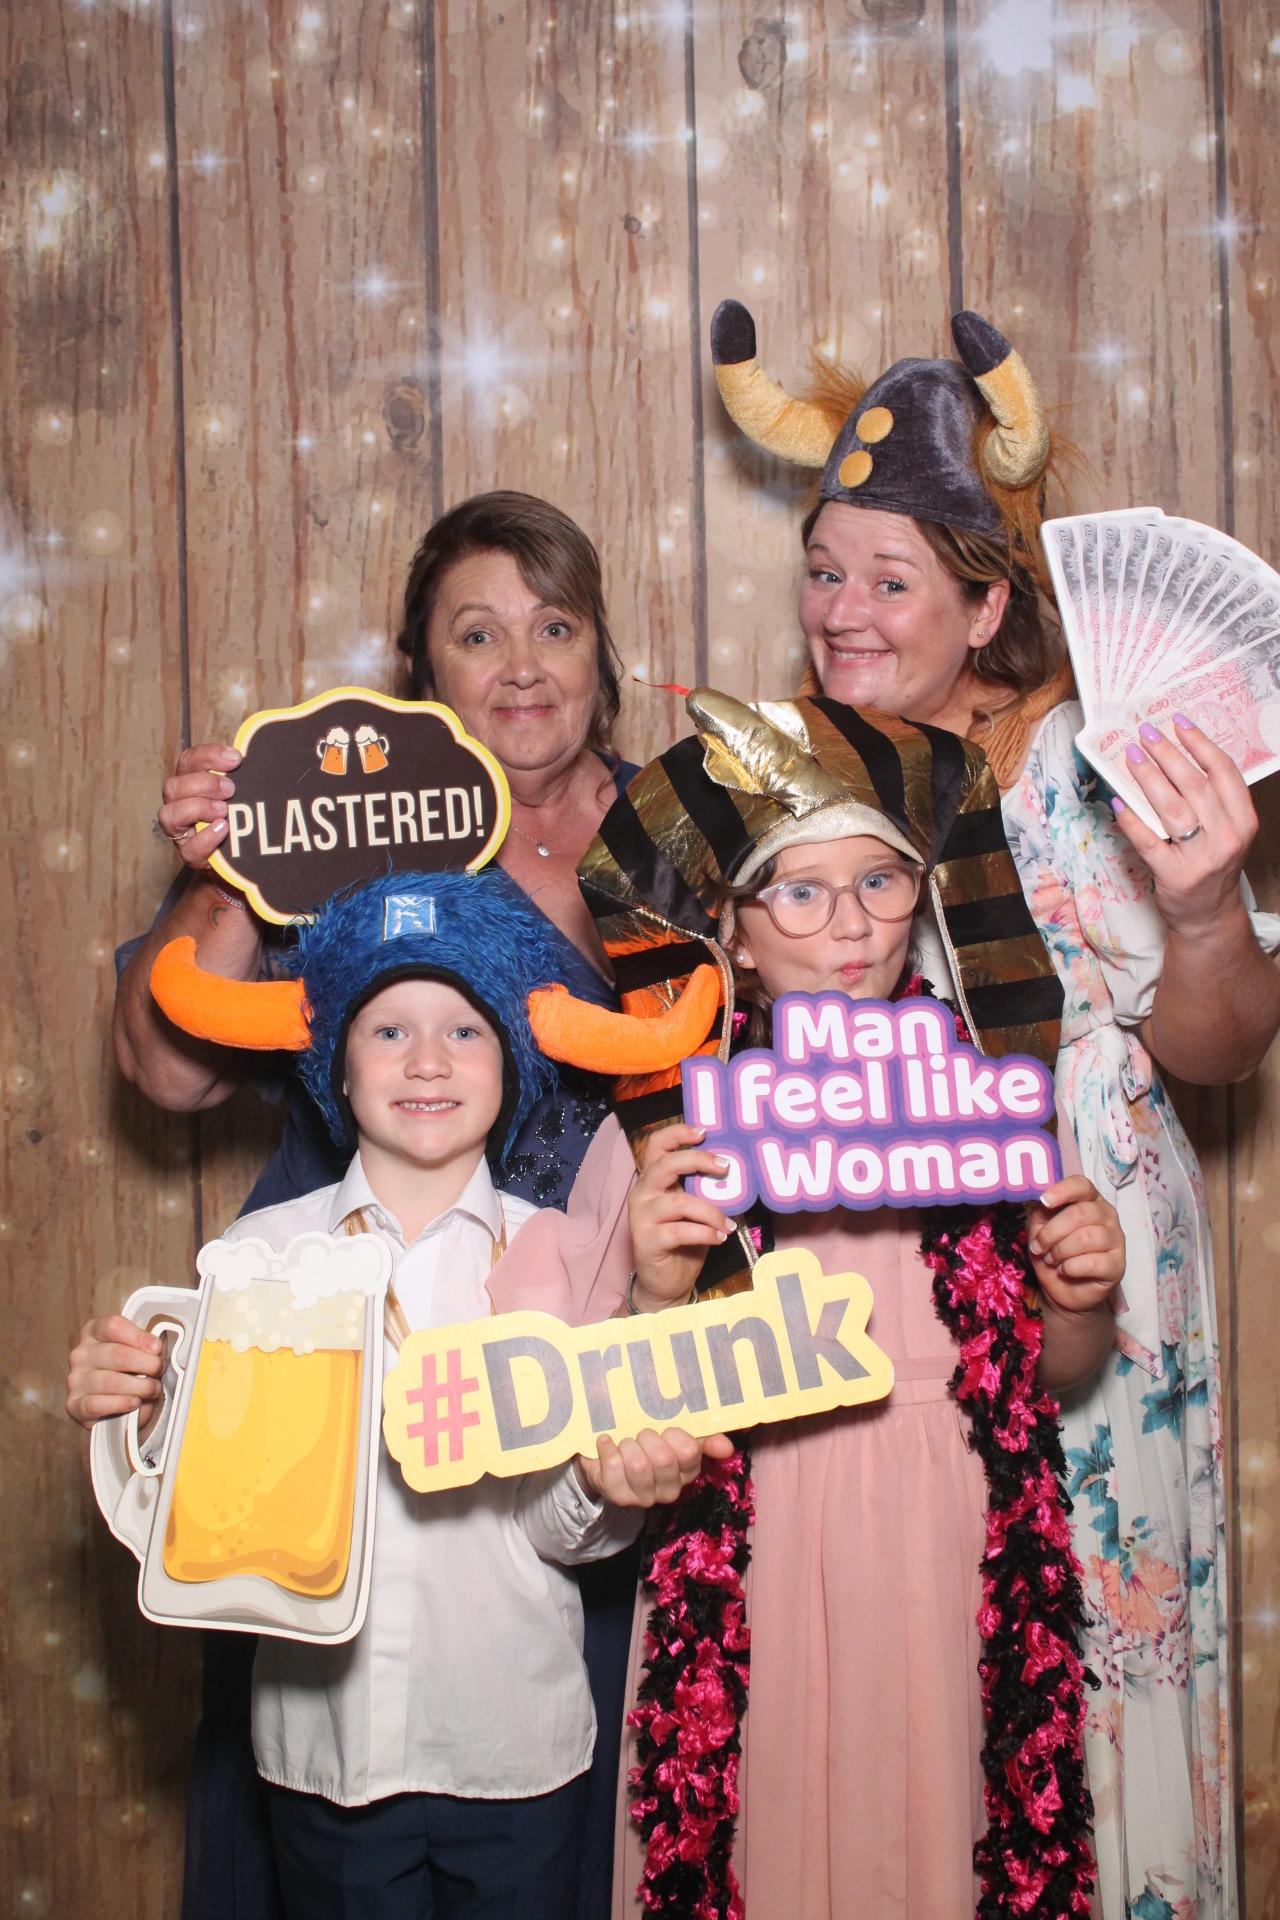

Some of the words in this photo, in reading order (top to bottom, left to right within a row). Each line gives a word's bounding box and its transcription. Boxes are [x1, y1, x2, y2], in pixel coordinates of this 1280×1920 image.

[1146, 698, 1169, 716] £50
[1099, 730, 1120, 753] £50
[228, 786, 484, 858] PLASTERED!
[787, 1004, 942, 1060] Man
[696, 1070, 717, 1125] I
[739, 1061, 887, 1124] feel
[906, 1054, 1042, 1117] like
[700, 1153, 742, 1200] a
[762, 1140, 1050, 1197] Woman
[405, 1273, 871, 1468] #Drunk
